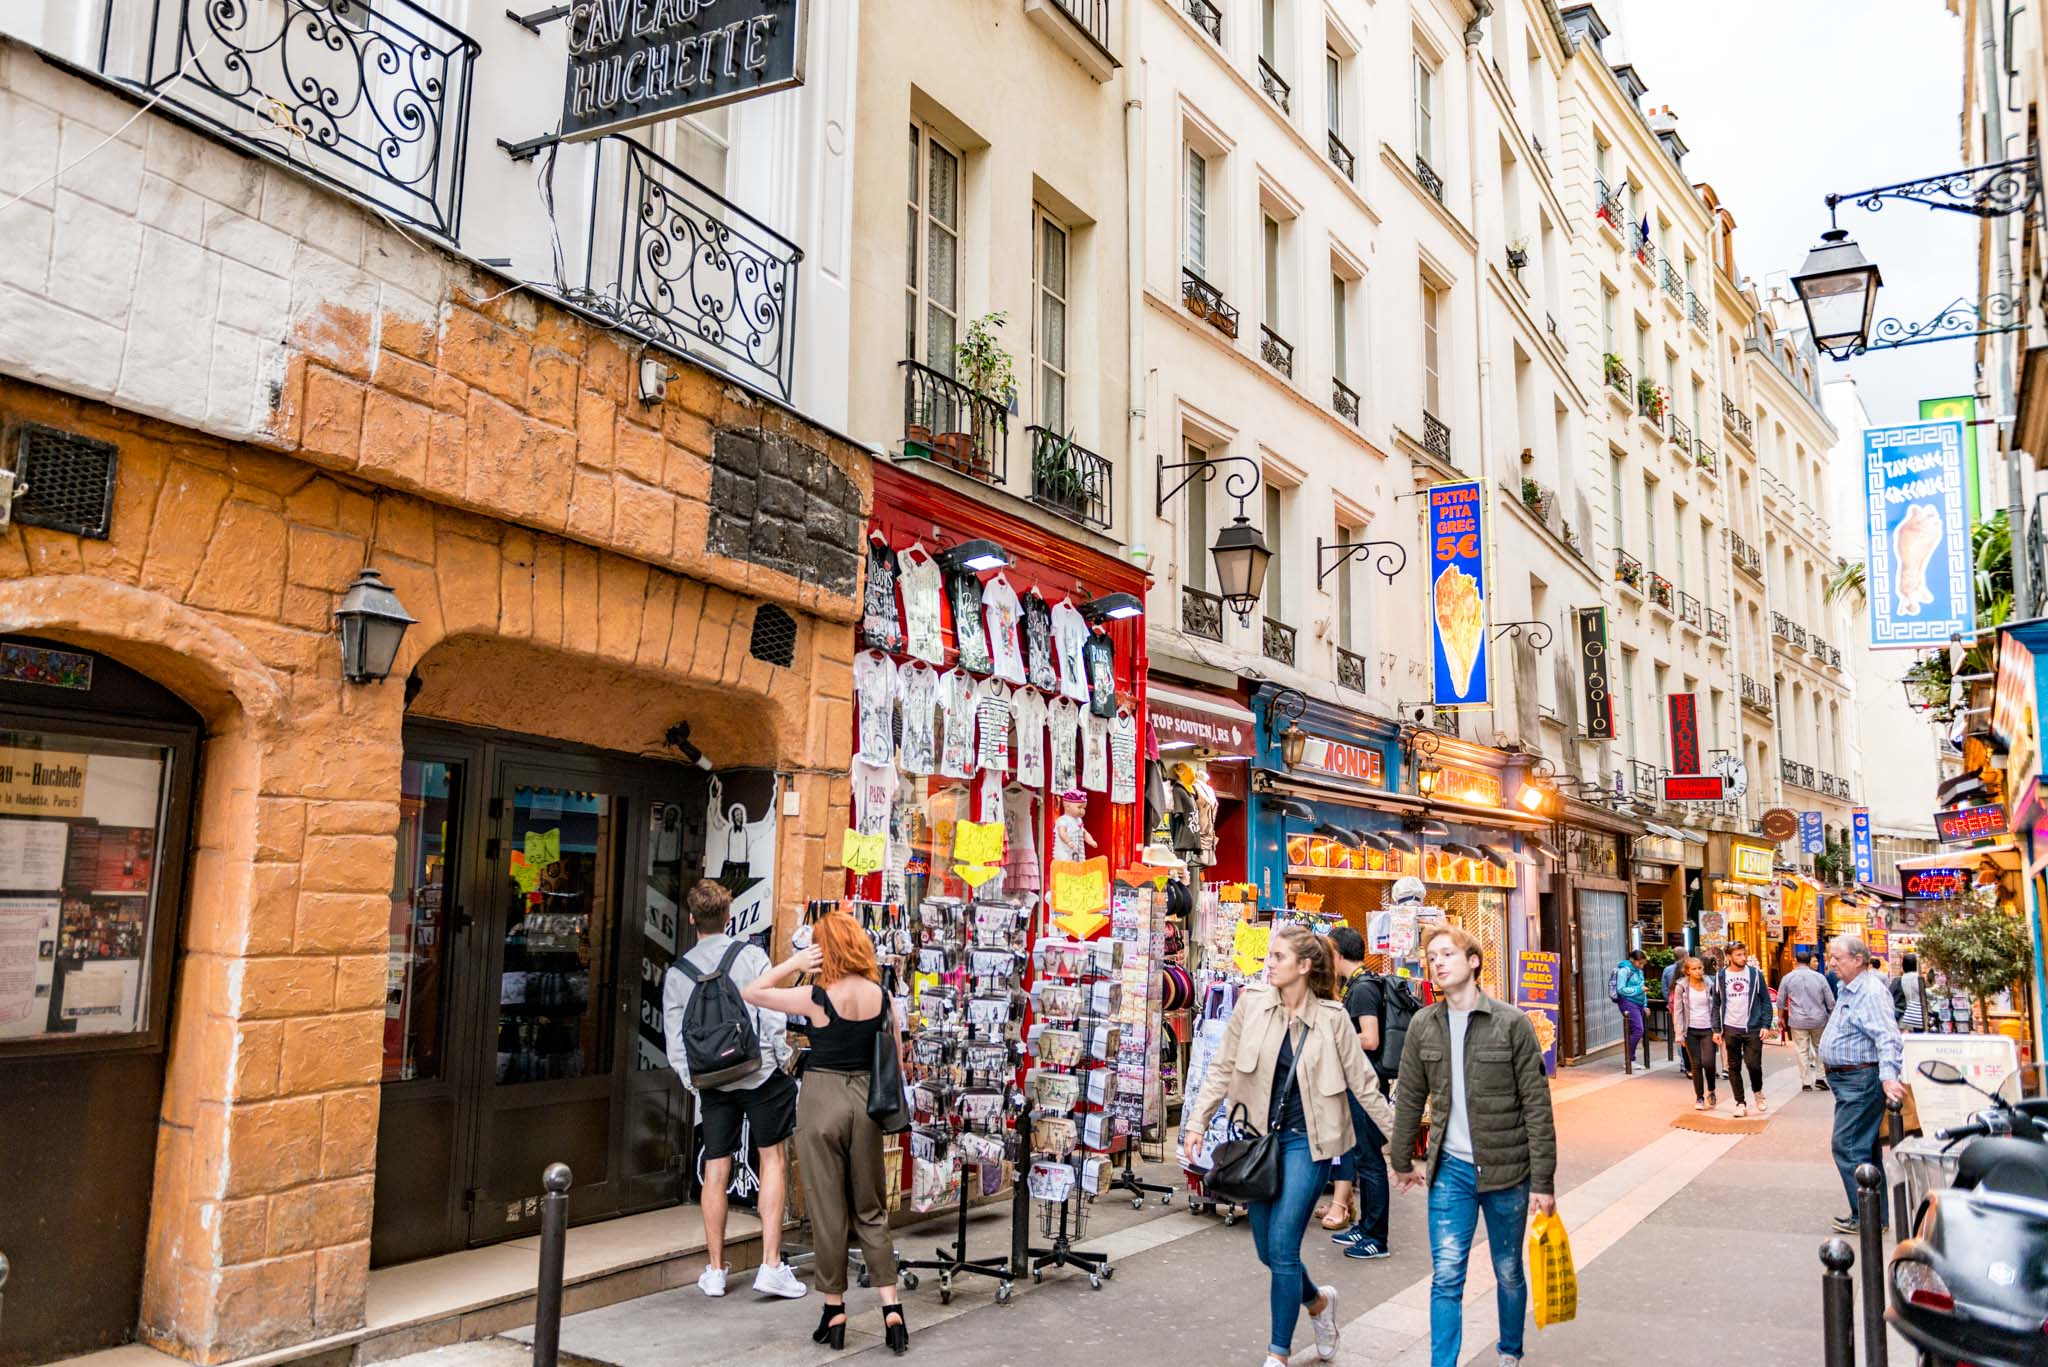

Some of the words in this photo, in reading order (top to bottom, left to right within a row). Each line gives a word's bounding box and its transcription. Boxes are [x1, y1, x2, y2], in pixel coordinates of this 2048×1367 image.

[573, 14, 778, 117] HUCHETTE
[1432, 489, 1479, 507] EXTRA
[1439, 504, 1472, 519] PITA
[1437, 519, 1476, 533] GREC
[1436, 533, 1480, 562] 5€
[1151, 713, 1174, 731] TOP
[32, 762, 83, 789] Huchette
[1943, 812, 2005, 834] CREPE
[1855, 816, 1871, 883] GYROS
[1907, 875, 1967, 893] CREPE
[726, 900, 761, 938] azz
[1521, 951, 1556, 963] EXTRA
[1527, 962, 1550, 973] PITA
[1523, 972, 1553, 983] GREC
